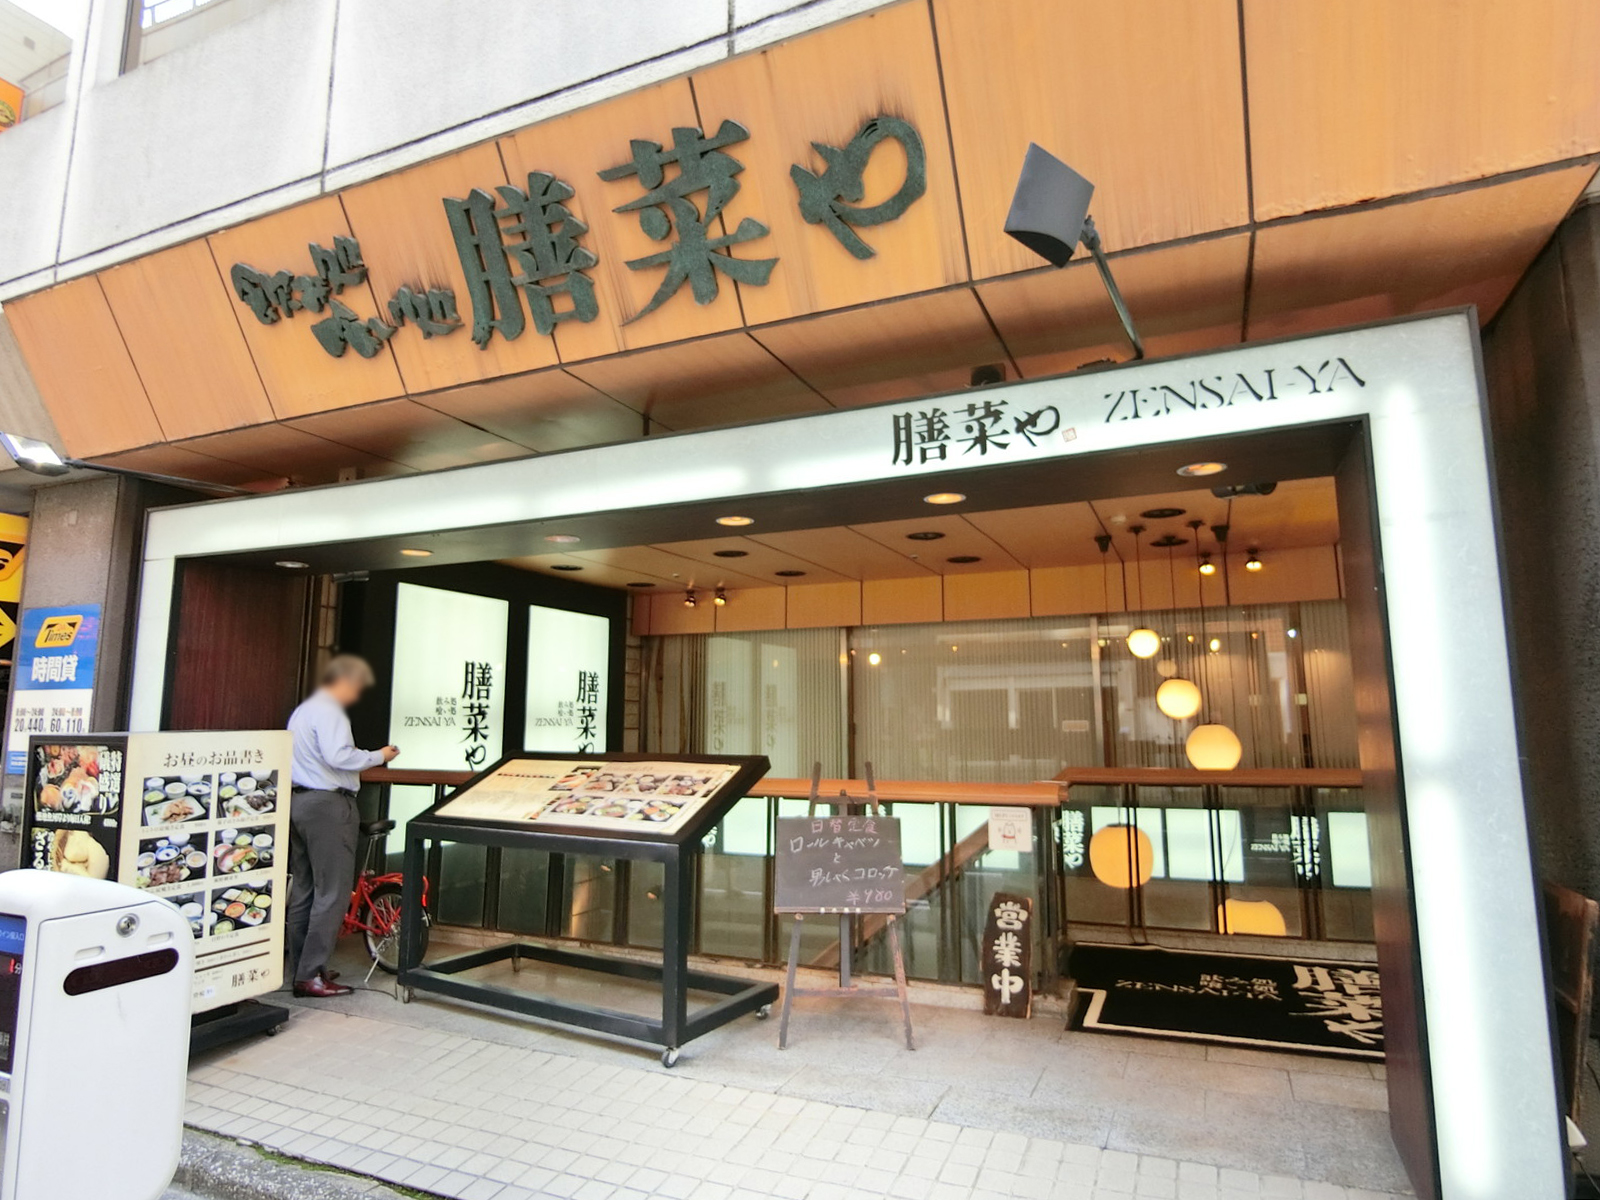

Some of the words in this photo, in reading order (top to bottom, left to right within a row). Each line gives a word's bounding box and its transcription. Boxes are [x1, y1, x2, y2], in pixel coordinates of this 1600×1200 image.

[442, 114, 927, 351] 膳菜や
[1103, 357, 1367, 424] ZENSAI-YA
[891, 399, 1061, 466] 膳菜や
[44, 629, 73, 643] Times
[31, 655, 79, 682] 時間貸
[458, 660, 494, 771] 膳菜や
[163, 749, 264, 768] お昼のお品書き
[811, 818, 878, 834] 日替定食
[790, 836, 880, 853] ロールキャベツ
[833, 852, 842, 863] と
[991, 900, 1029, 1004] 営業中
[231, 968, 270, 988] 膳菜や
